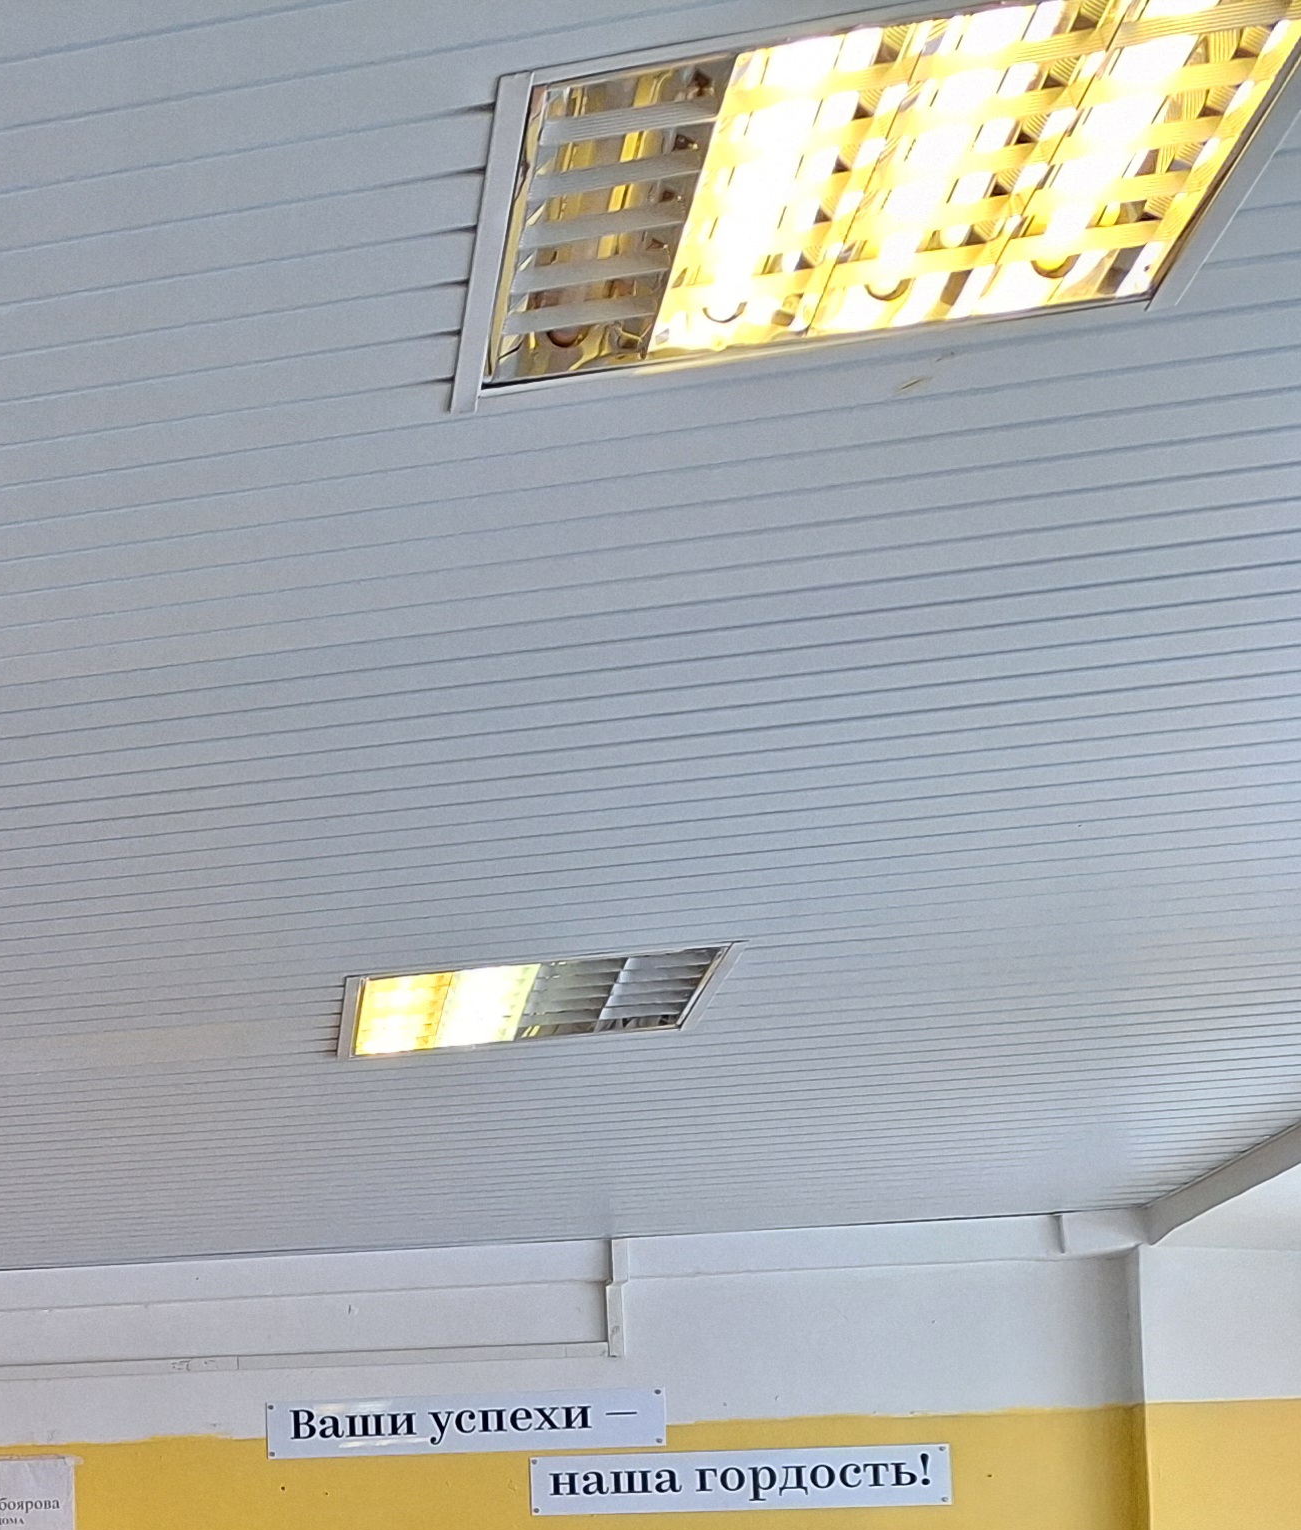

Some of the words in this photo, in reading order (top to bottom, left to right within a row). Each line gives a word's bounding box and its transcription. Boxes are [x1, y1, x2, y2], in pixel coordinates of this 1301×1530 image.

[289, 1409, 417, 1441] Ваши
[427, 1405, 593, 1446] успехи
[549, 1468, 683, 1497] наша
[695, 1452, 932, 1503] гордость!
